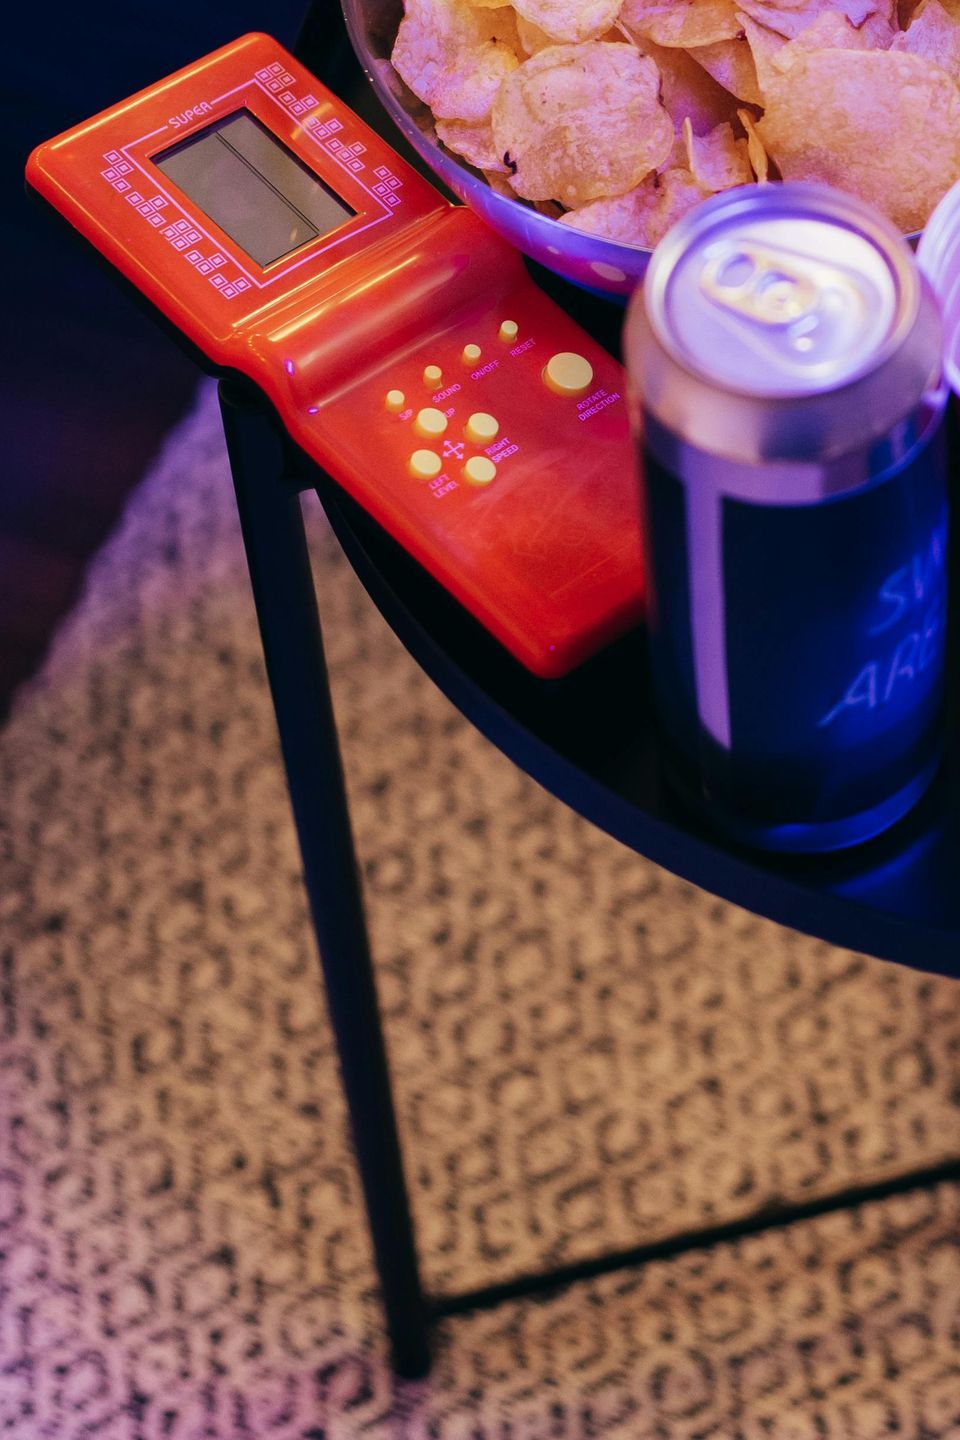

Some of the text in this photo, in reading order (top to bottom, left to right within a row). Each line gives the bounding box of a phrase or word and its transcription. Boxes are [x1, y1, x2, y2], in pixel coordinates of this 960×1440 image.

[509, 337, 536, 358] RESET
[470, 359, 500, 381] ON/OFF
[432, 383, 462, 403] SOUND
[576, 388, 608, 416] ROTATE
[577, 392, 621, 422] DIRECTION
[491, 444, 519, 463] SPEED
[428, 473, 450, 491] LEFT
